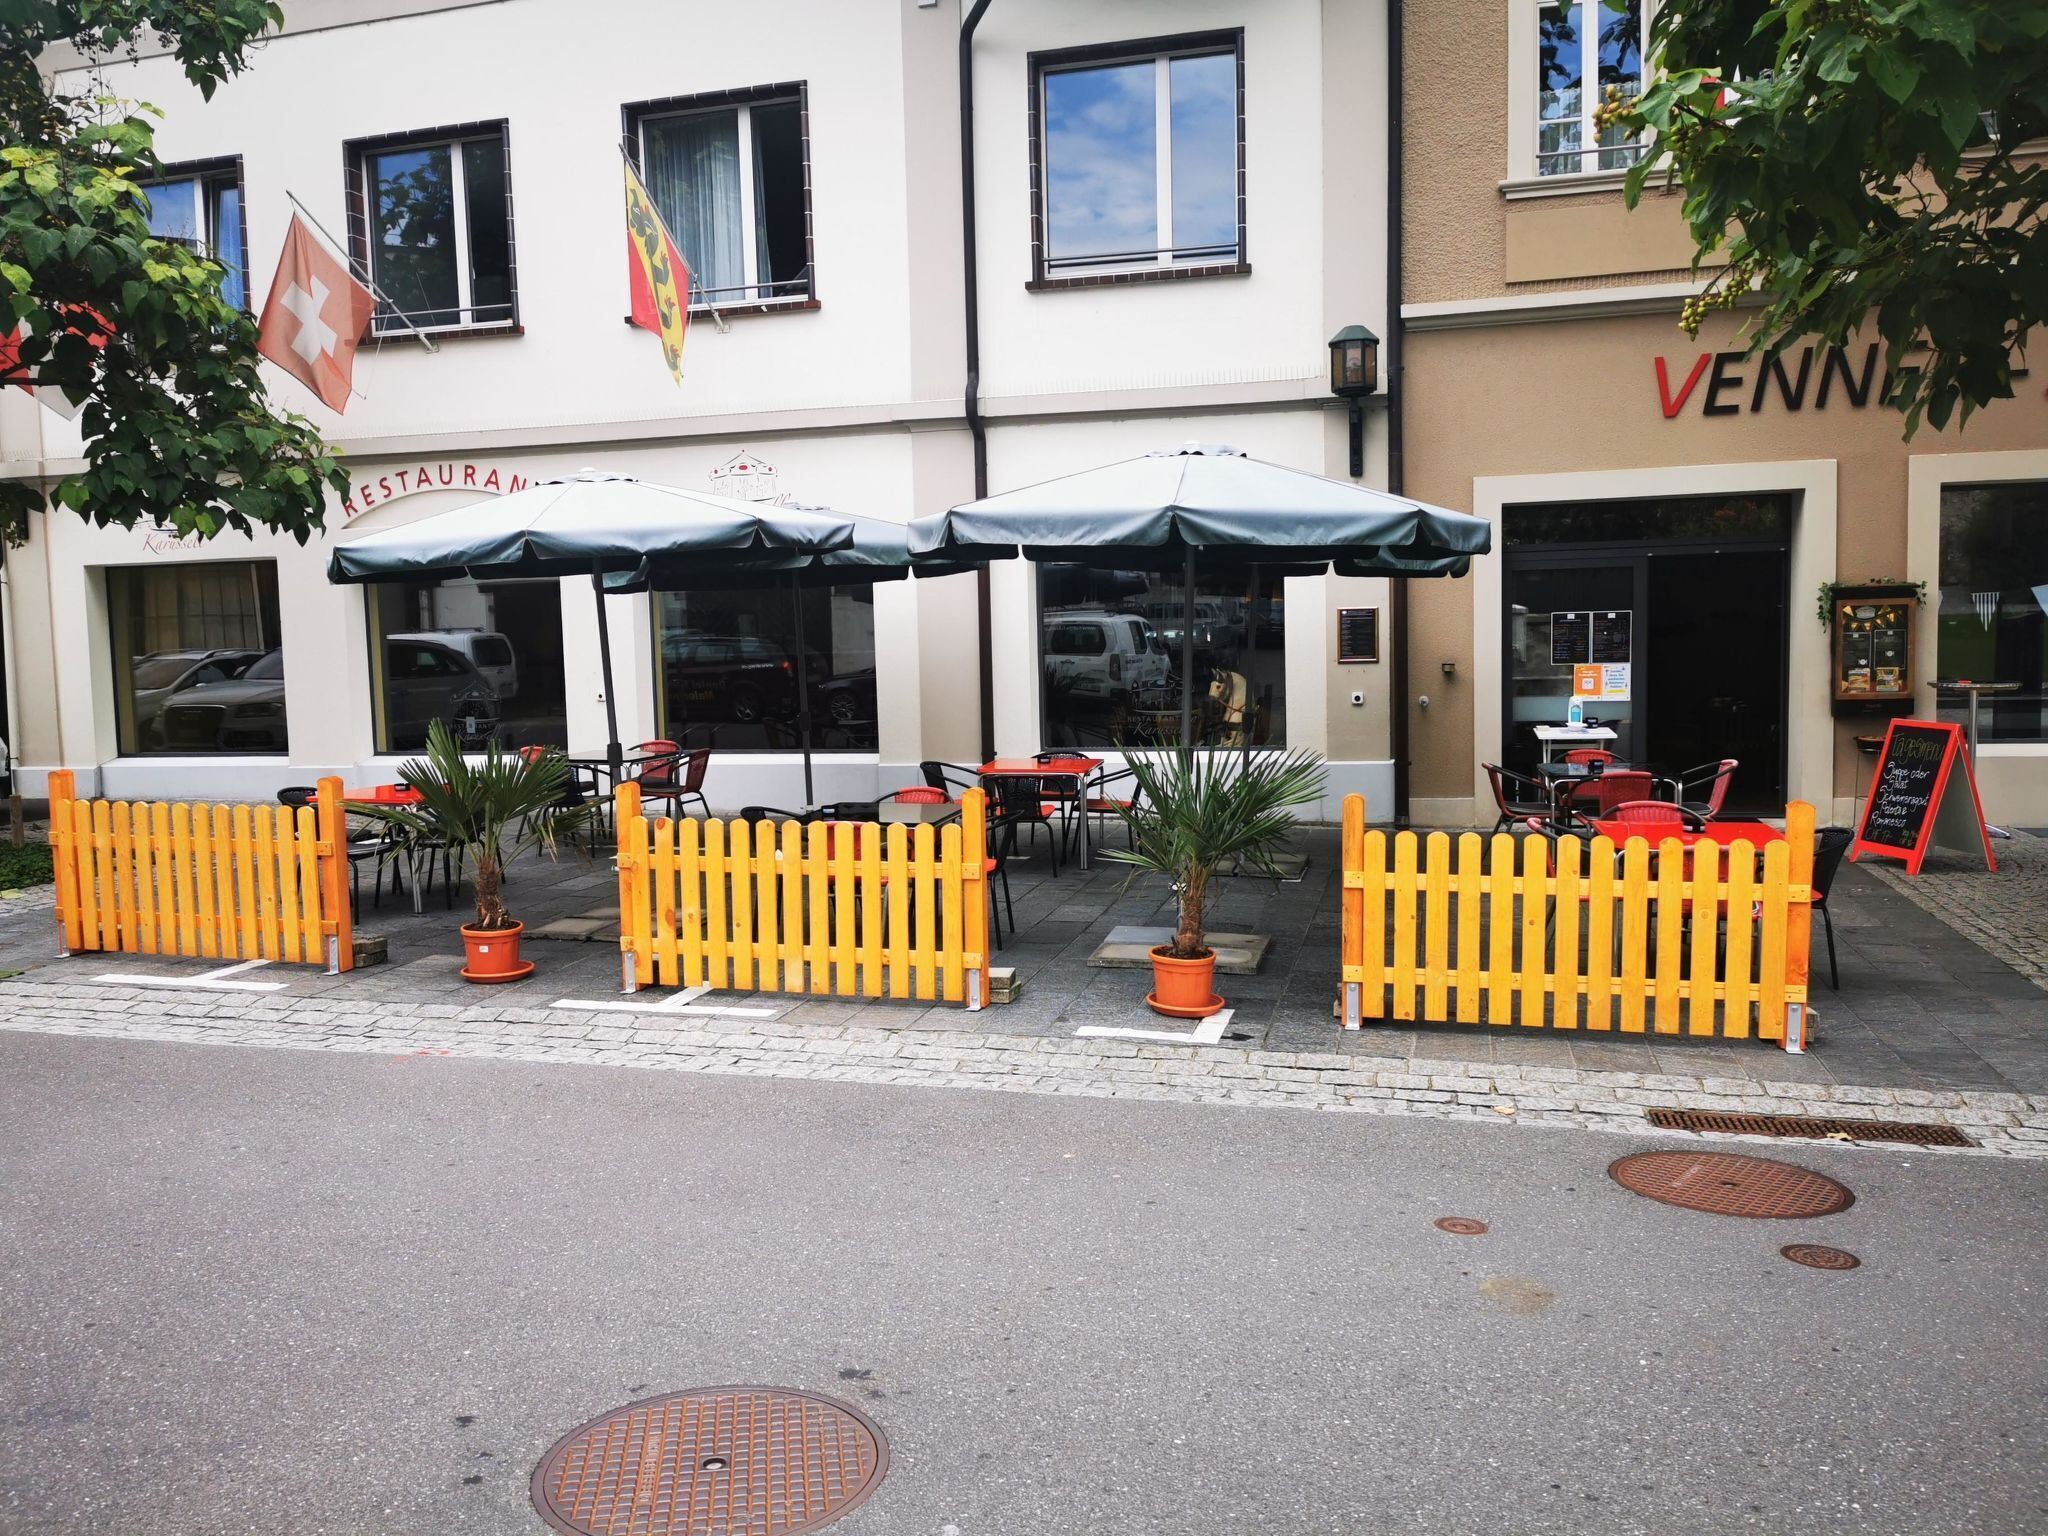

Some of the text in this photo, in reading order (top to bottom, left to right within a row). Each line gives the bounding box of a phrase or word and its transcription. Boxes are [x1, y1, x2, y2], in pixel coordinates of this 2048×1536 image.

[342, 463, 527, 518] RESTAURAN
[1884, 761, 1930, 782] Suppe oder
